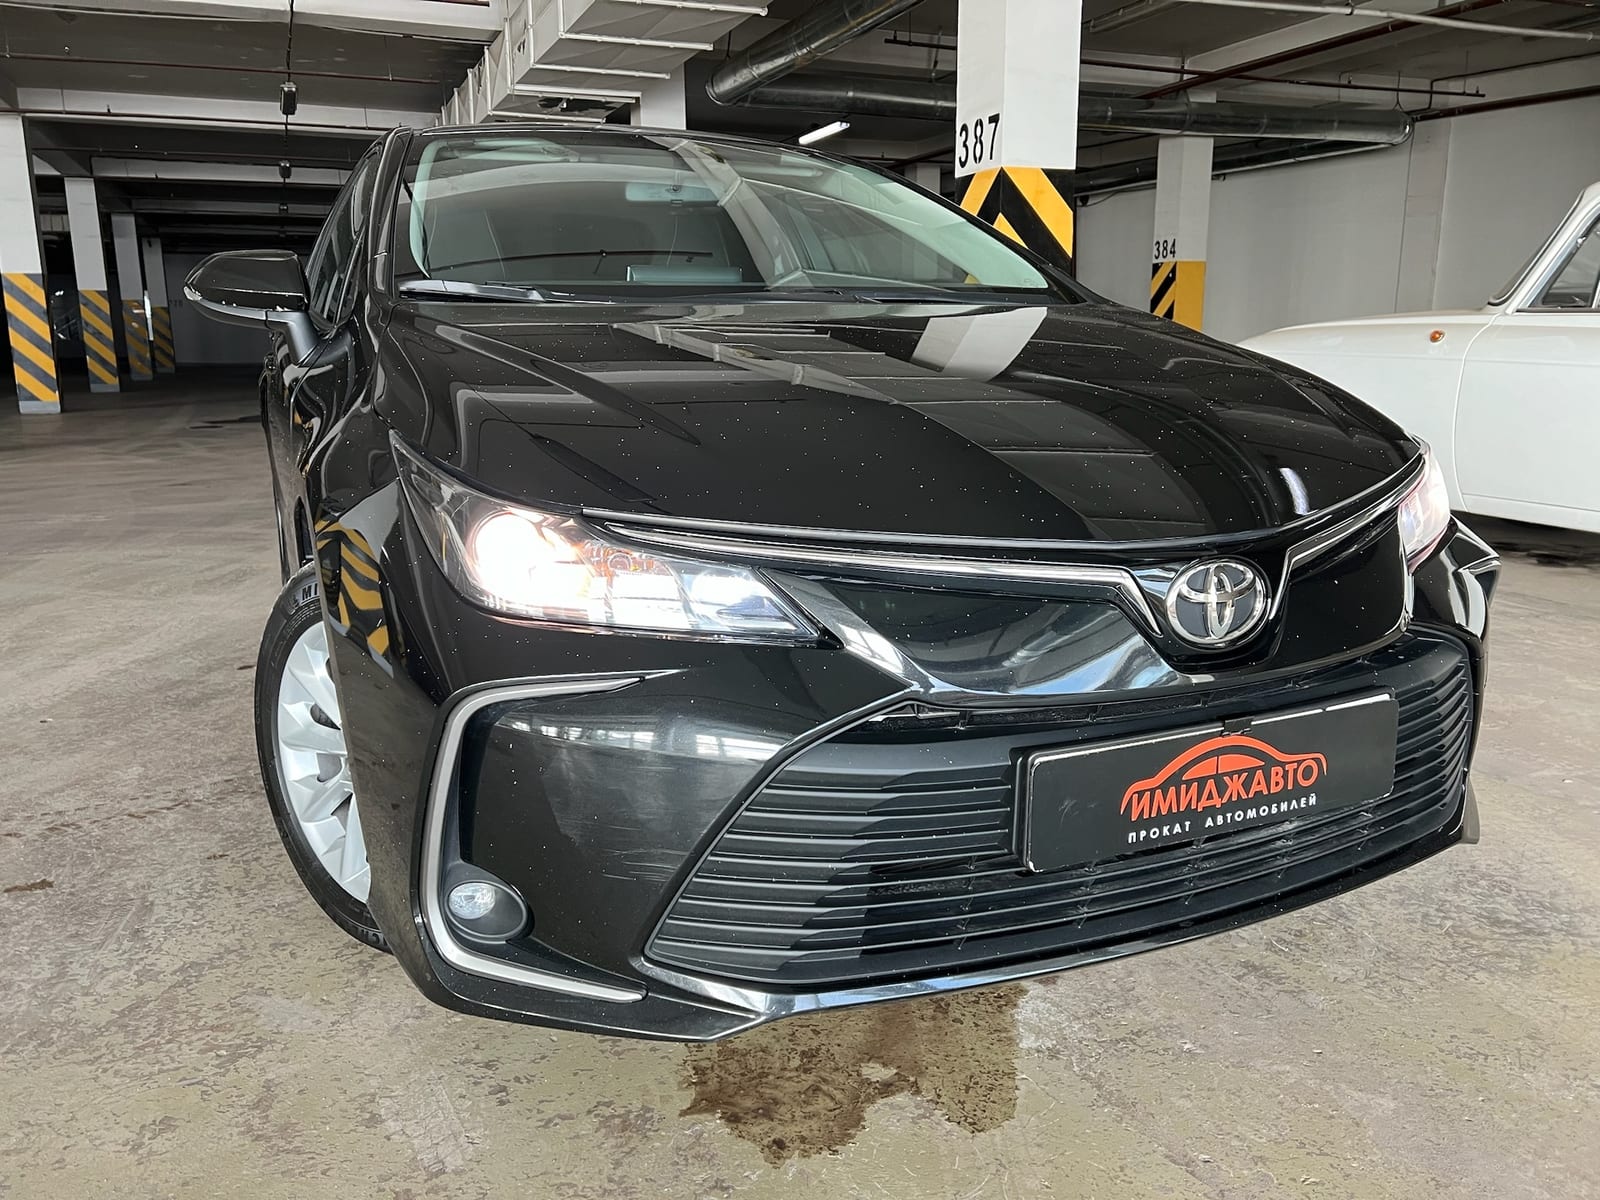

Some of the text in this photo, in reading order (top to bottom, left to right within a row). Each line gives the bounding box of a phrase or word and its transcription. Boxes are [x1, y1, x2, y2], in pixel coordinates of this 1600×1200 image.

[958, 112, 1001, 169] 387
[1154, 238, 1176, 260] 384
[1130, 758, 1319, 822] ИМИДЖАВТО
[1127, 792, 1318, 844] ПРОКАТ АВТОМОБИЛЕЙ
